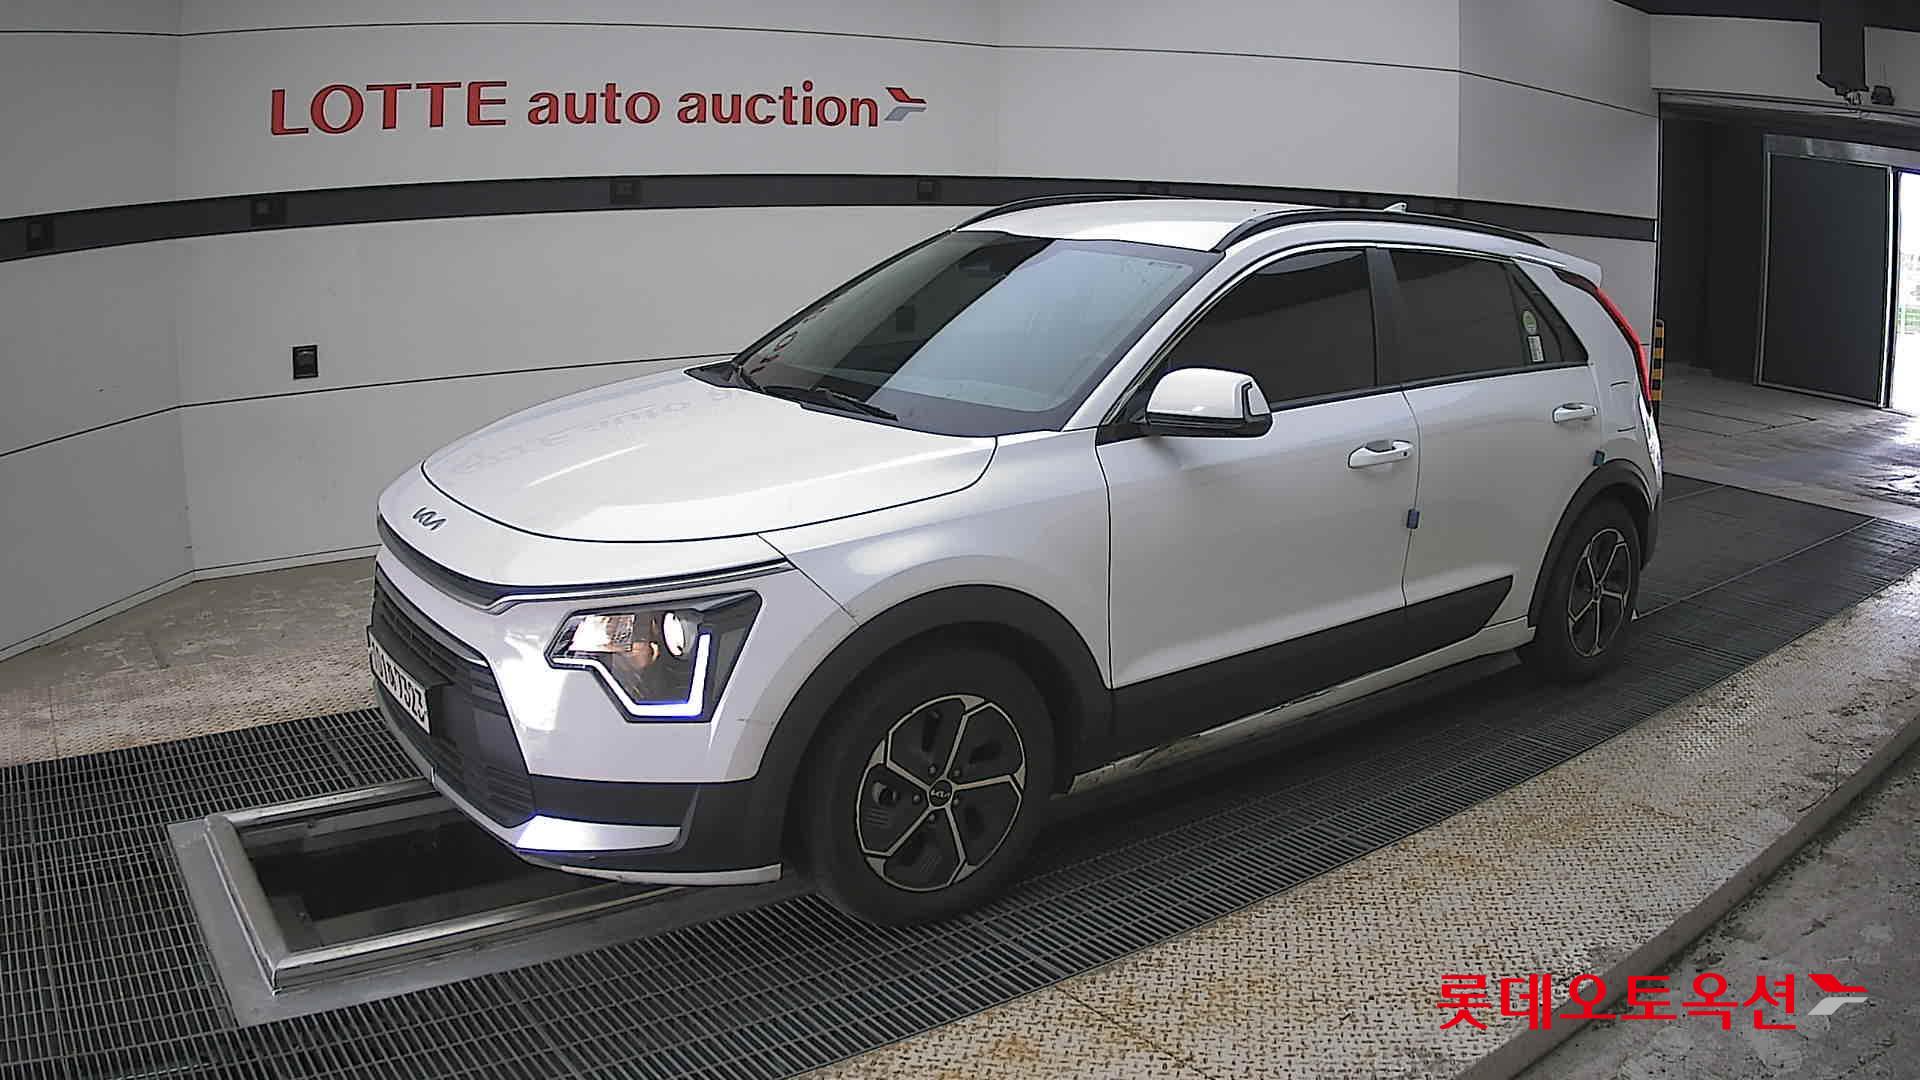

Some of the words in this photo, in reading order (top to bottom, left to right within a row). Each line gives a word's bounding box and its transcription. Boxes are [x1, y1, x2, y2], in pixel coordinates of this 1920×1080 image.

[270, 81, 507, 136] LOTTE
[527, 82, 662, 126] auto
[677, 80, 878, 128] auction
